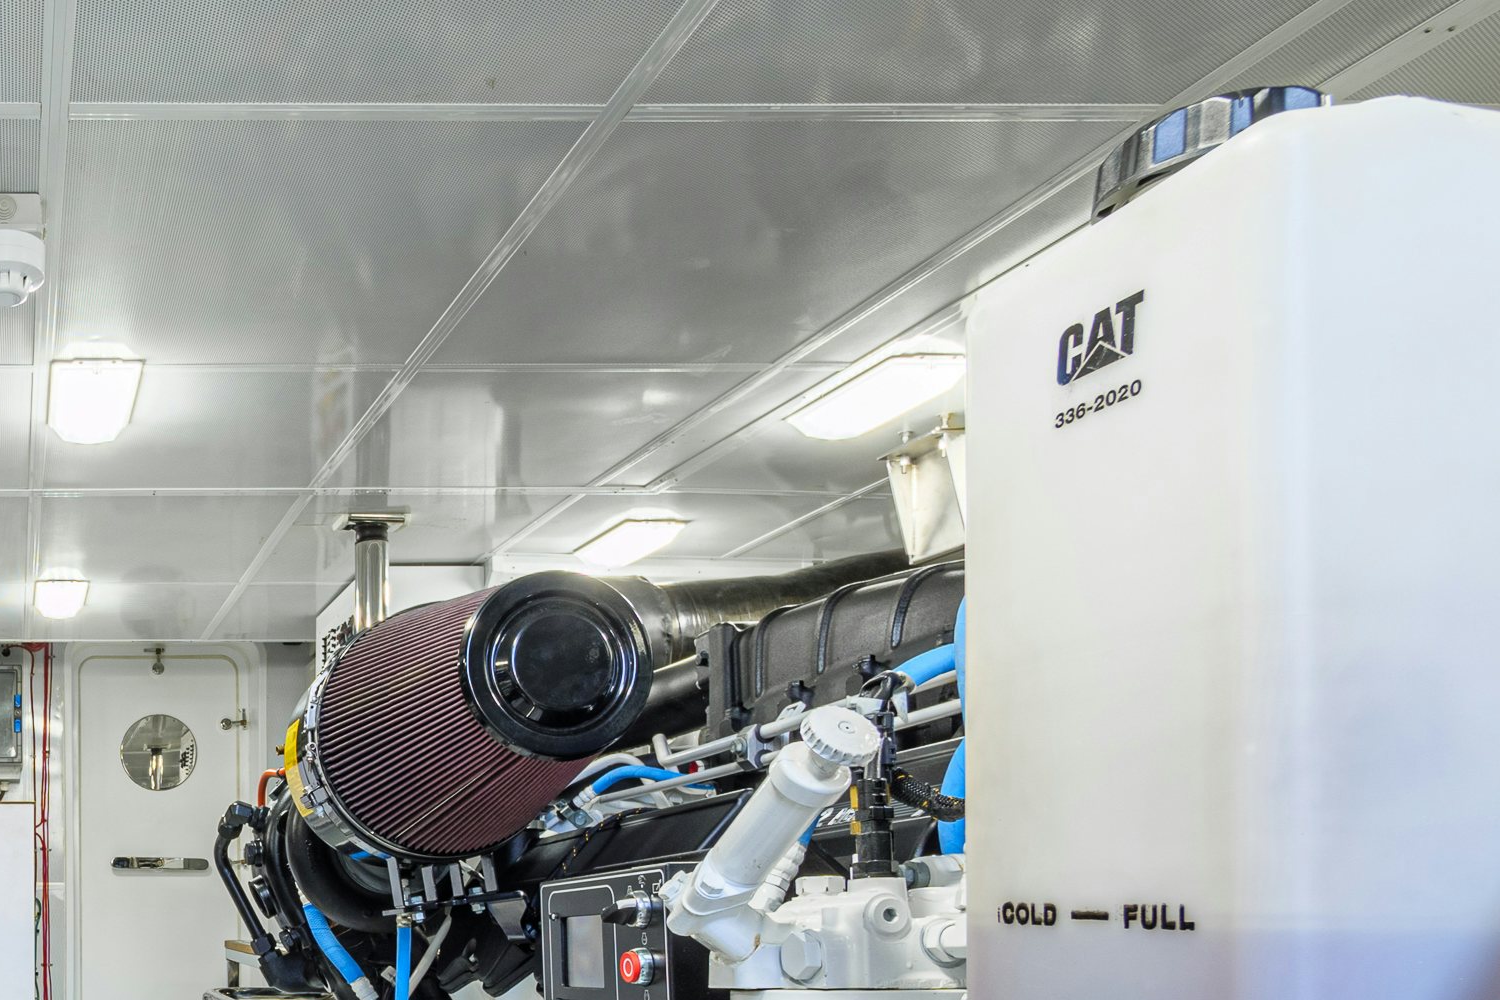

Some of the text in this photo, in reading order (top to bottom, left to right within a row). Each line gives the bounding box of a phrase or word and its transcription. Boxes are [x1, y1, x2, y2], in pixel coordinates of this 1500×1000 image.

[1057, 289, 1145, 386] CAT
[1055, 379, 1142, 429] 336-2020
[1002, 901, 1195, 931] COLD FULL
